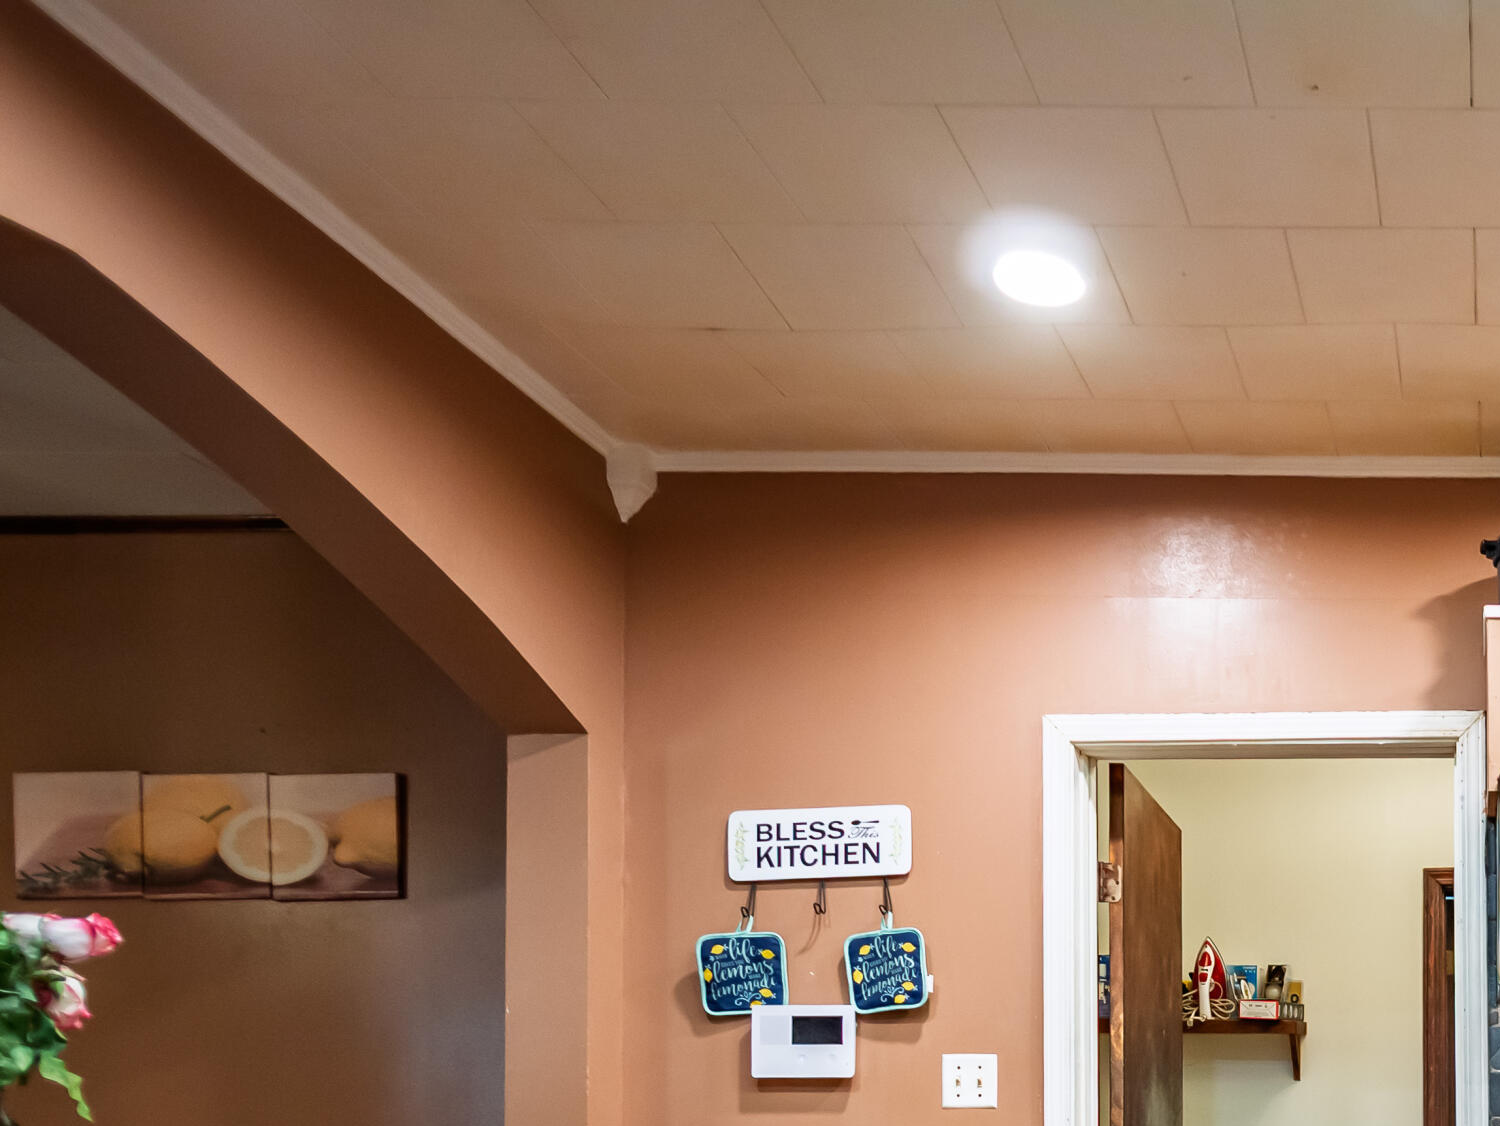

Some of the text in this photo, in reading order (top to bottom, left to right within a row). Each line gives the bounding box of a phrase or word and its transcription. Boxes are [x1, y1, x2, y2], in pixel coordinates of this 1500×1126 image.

[756, 820, 845, 842] BLESS
[756, 841, 881, 869] KITCHEN
[713, 959, 774, 984] lemons
[862, 953, 915, 983] lemons
